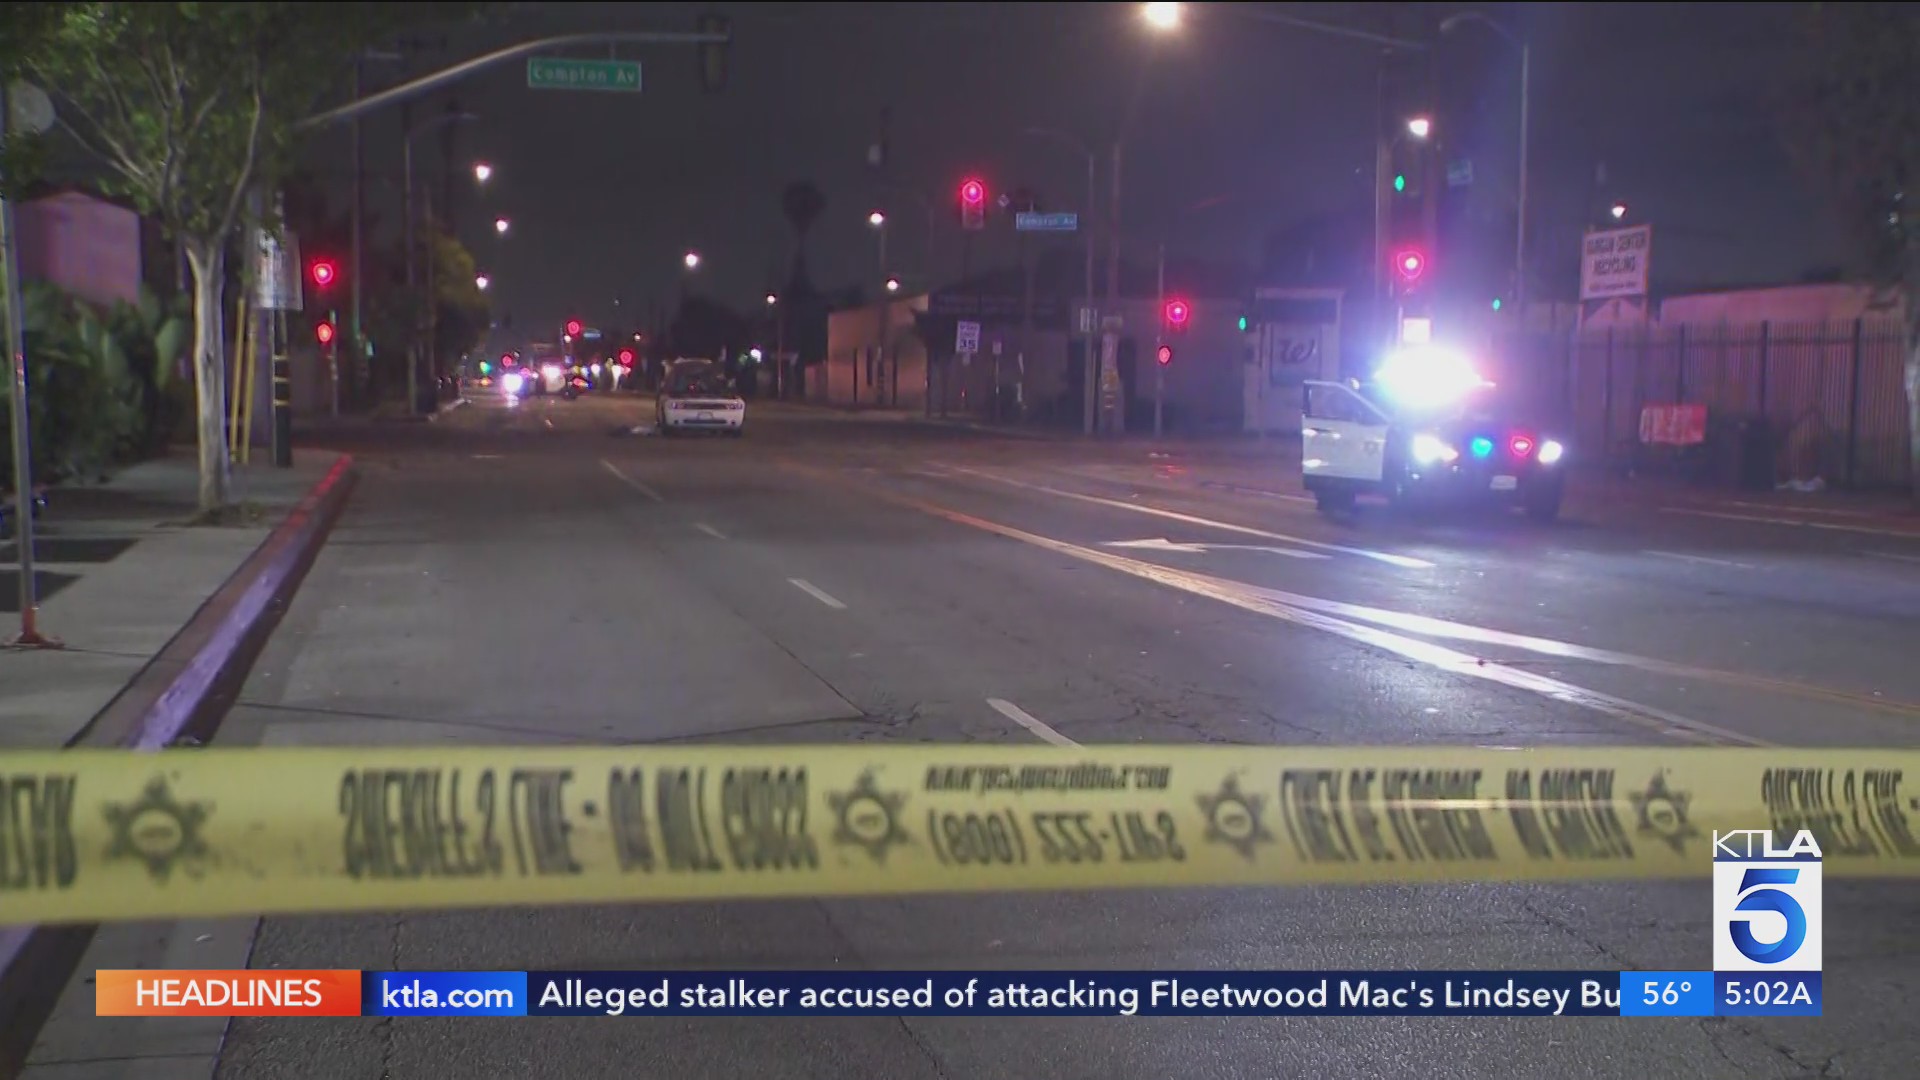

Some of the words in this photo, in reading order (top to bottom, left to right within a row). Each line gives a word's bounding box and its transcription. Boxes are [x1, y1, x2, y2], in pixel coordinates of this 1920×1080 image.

[532, 66, 607, 82] Compton
[615, 67, 636, 83] Av
[959, 338, 977, 350] 35
